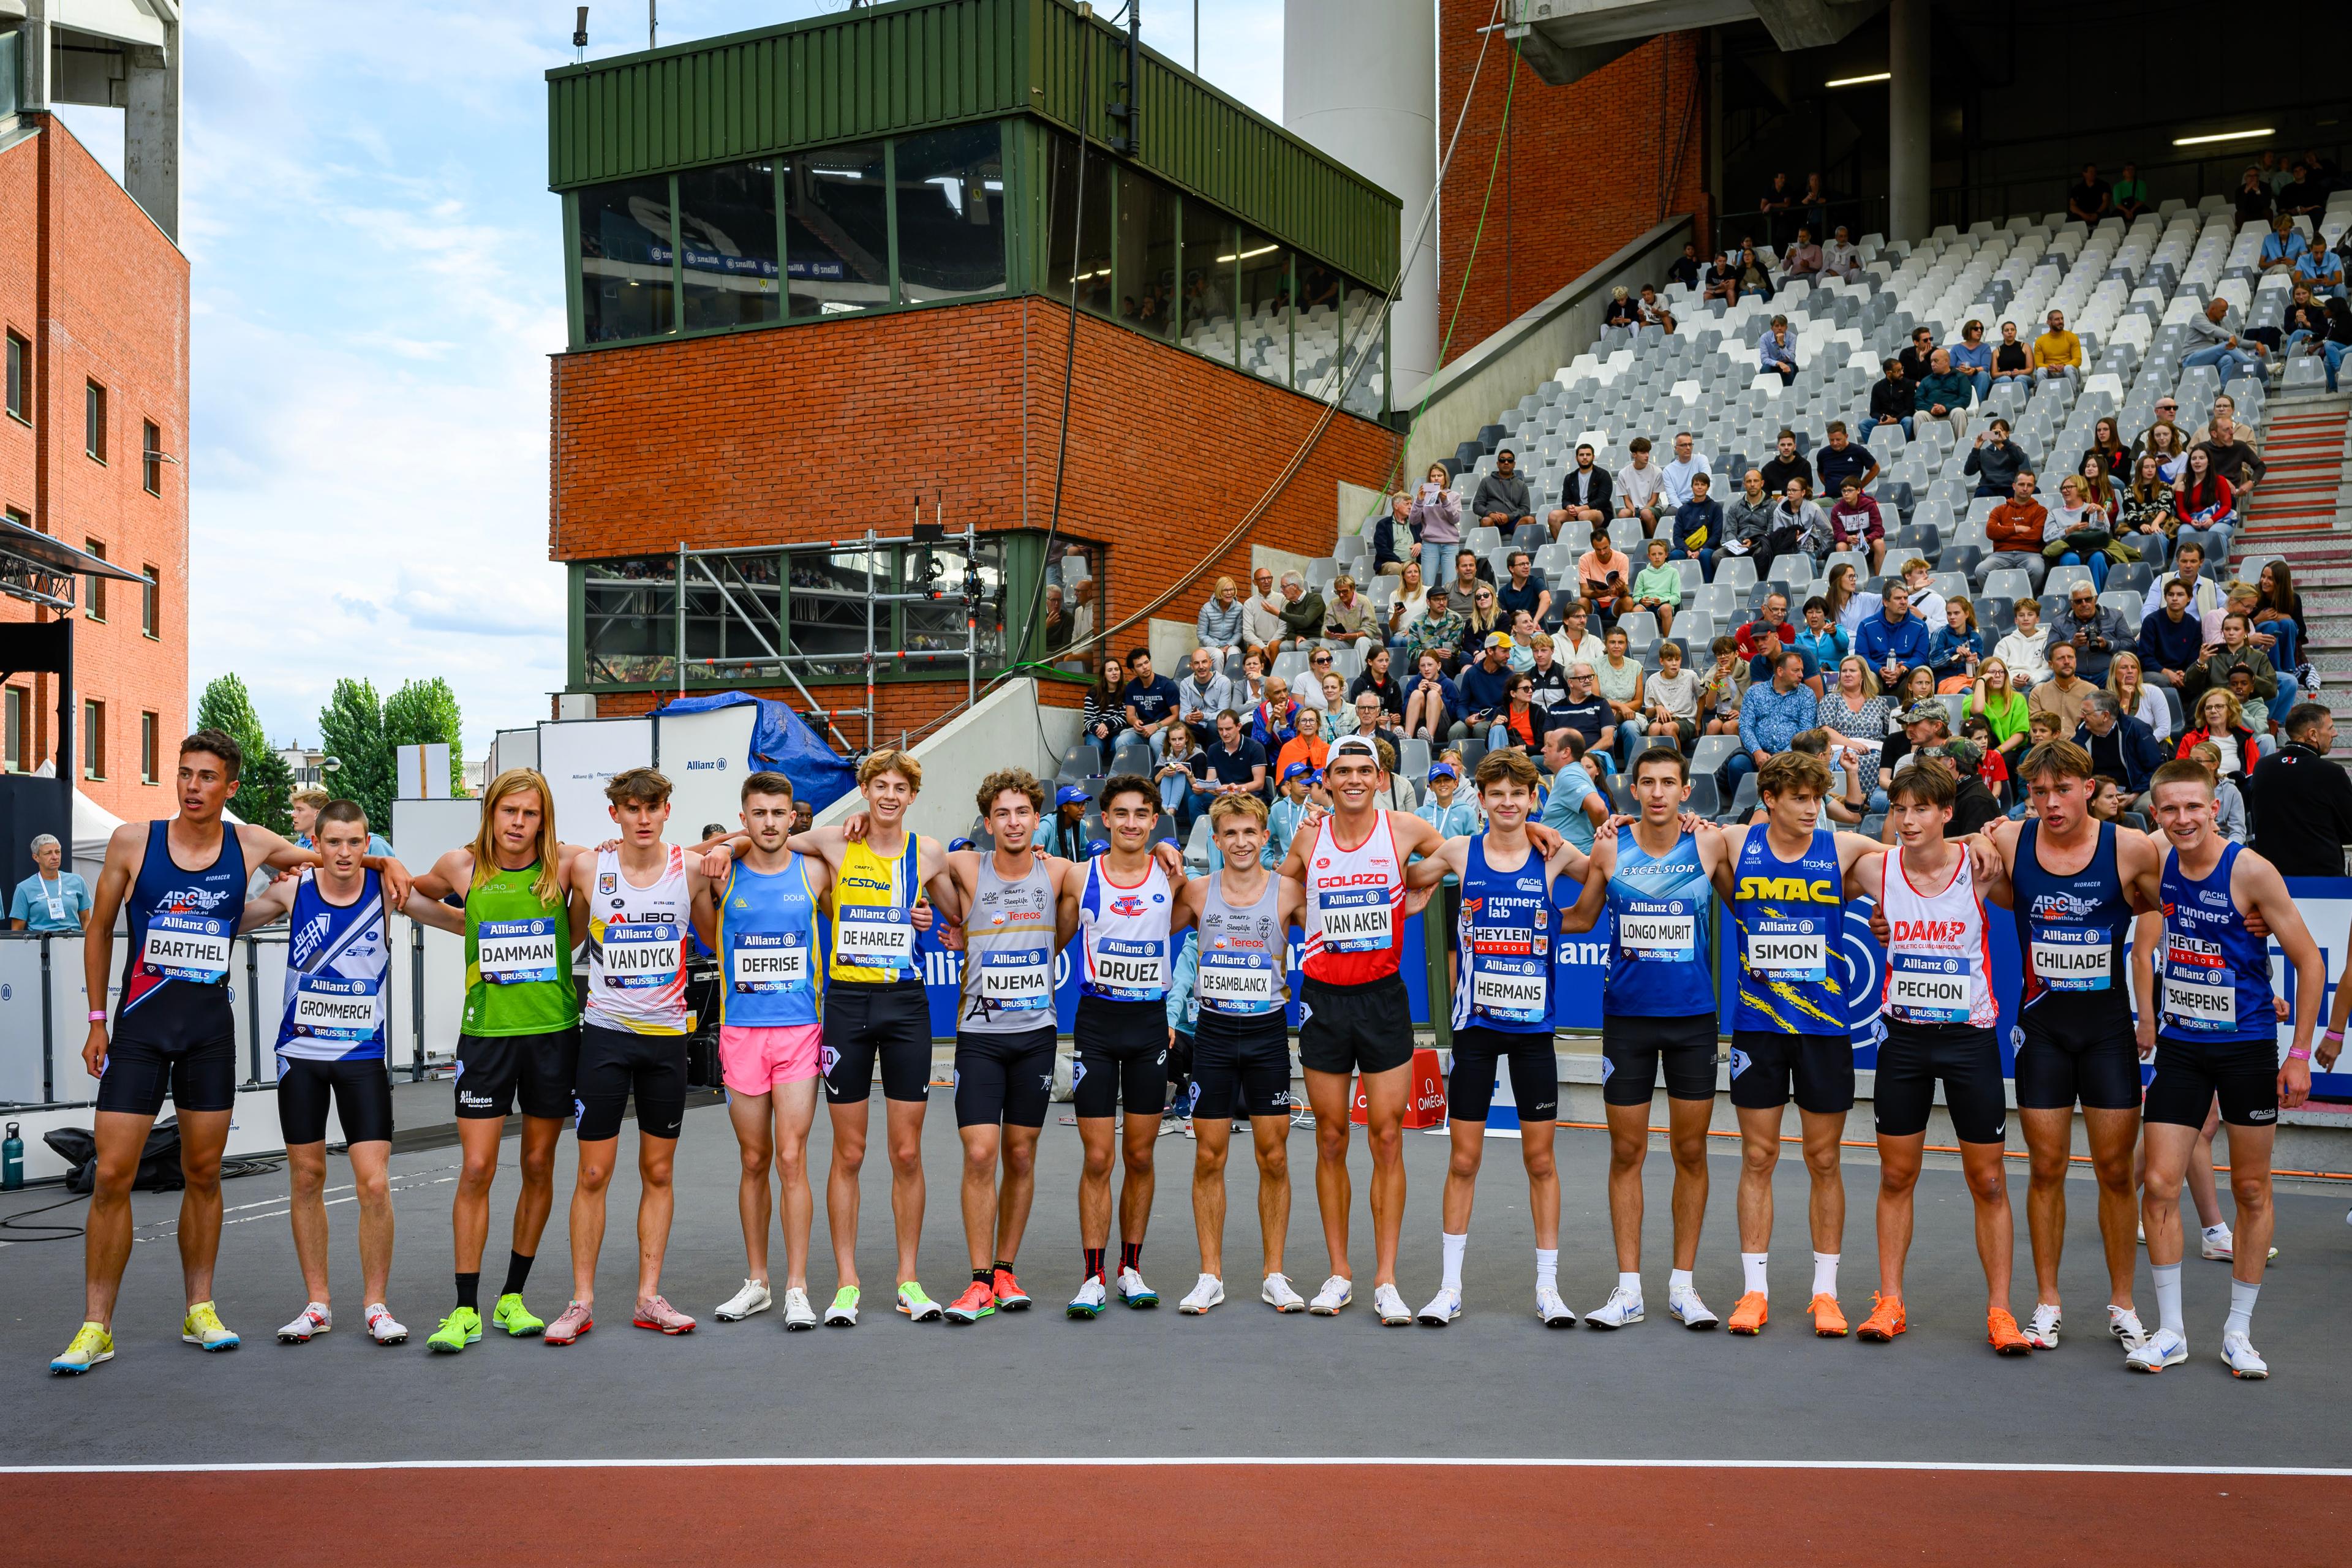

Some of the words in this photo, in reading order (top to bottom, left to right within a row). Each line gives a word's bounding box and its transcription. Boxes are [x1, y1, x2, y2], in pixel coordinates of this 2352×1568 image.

[687, 760, 714, 770] Allianz
[1621, 864, 1695, 876] EXCELSIOR
[1317, 873, 1388, 888] GOLAZO
[1735, 877, 1840, 904] SMAC
[2206, 891, 2228, 900] ACHL
[1115, 899, 1142, 907] MOHA
[1329, 894, 1364, 905] Allianz
[1488, 897, 1545, 908] runners'
[1488, 907, 1510, 918] lab
[1629, 902, 1667, 912] Allianz
[850, 908, 885, 919] Allianz
[1008, 911, 1041, 921] Tereos
[2030, 913, 2083, 921] www.archathle.eu
[2177, 905, 2233, 924] runners'
[162, 916, 203, 930] Allianz
[1325, 914, 1351, 933] VAN
[1354, 911, 1387, 932] AKEN
[1758, 922, 1797, 932] Allianz
[2179, 915, 2196, 929] lab
[490, 924, 529, 935] Allianz
[614, 929, 652, 940] Allianz
[1475, 929, 1530, 941] HEYLEN
[1623, 924, 1656, 939] LONGO
[1659, 925, 1691, 940] MURIT
[1894, 921, 1966, 941] DAMP
[2043, 930, 2082, 941] Allianz
[744, 936, 781, 946] Allianz
[843, 930, 858, 945] DE
[861, 931, 904, 947] HARLEZ
[1230, 937, 1264, 948] Tereos
[1341, 940, 1379, 949] BRUSSELS
[2169, 933, 2220, 955] HEYLEN
[150, 939, 224, 962] BARTHEL
[482, 943, 553, 963] DAMMAN
[1108, 942, 1143, 954] Allianz
[1755, 944, 1817, 959] SIMON
[609, 949, 637, 969] VAN
[641, 948, 675, 968] DYCK
[855, 956, 894, 965] BRUSSELS
[992, 954, 1027, 964] Allianz
[1210, 954, 1245, 965] Allianz
[1903, 958, 1941, 970] Allianz
[2036, 952, 2106, 969] CHILIADE
[742, 957, 799, 973] DEFRISE
[1099, 960, 1159, 981] DRUEZ
[1485, 960, 1520, 972] Allianz
[165, 968, 210, 979] BRUSSELS
[501, 971, 542, 981] BRUSSELS
[2173, 966, 2205, 981] Allianz
[311, 979, 350, 992] Allianz
[624, 976, 665, 985] BRUSSELS
[754, 982, 793, 991] BRUSSELS
[987, 973, 1045, 990] NJEMA
[1204, 975, 1214, 989] DE
[1215, 976, 1267, 992] SAMBLANCX
[1112, 989, 1149, 997] BRUSSELS
[1478, 981, 1541, 1000] HERMANS
[1898, 981, 1962, 1000] PECHON
[1001, 998, 1037, 1008] BRUSSELS
[1218, 1001, 1255, 1009] BRUSSELS
[2169, 989, 2229, 1011] SCHEPENS
[300, 1000, 371, 1020] GROMMERCH
[1490, 1008, 1529, 1018] BRUSSELS
[1910, 1009, 1953, 1018] BRUSSELS
[2180, 1017, 2219, 1030] BRUSSELS
[314, 1028, 356, 1038] BRUSSELS
[821, 1050, 834, 1065] 10
[1733, 1054, 1740, 1068] 3
[1418, 1094, 1446, 1110] OMEGA
